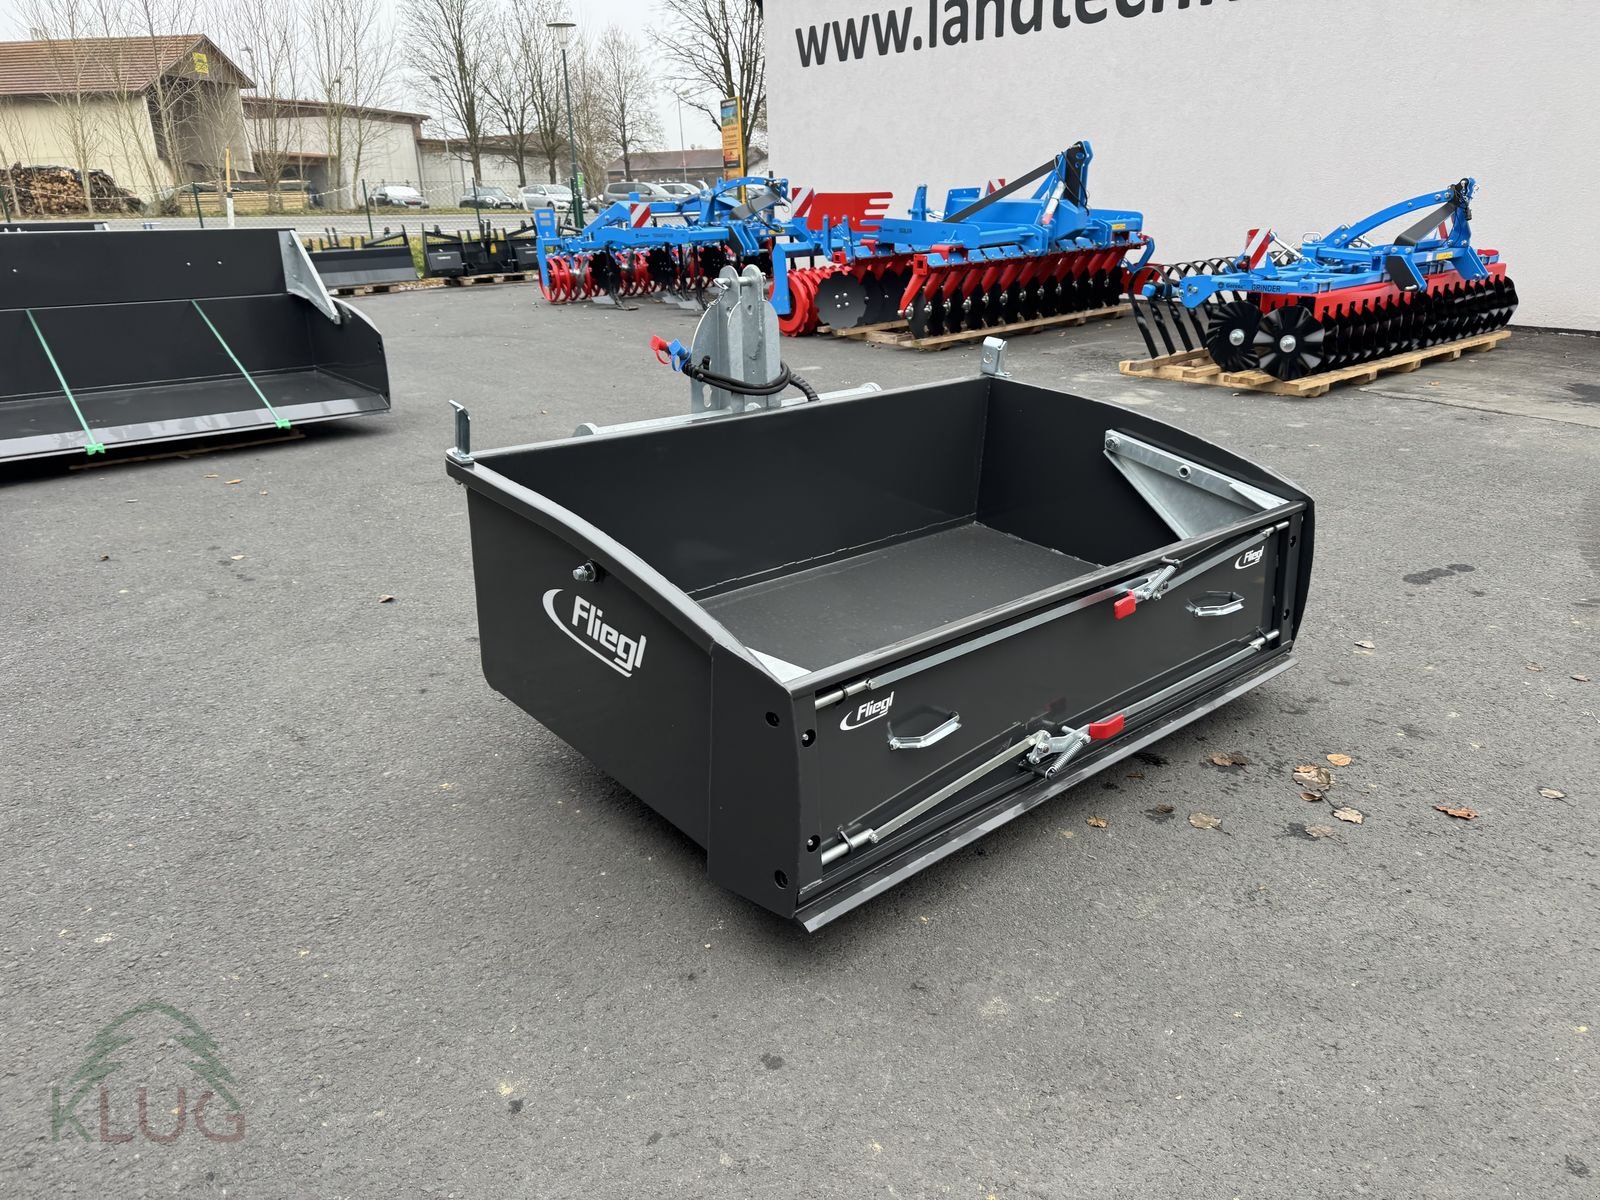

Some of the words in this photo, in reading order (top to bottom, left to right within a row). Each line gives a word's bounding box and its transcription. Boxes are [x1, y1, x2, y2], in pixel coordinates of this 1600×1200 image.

[794, 0, 1237, 68] www.landte
[1251, 284, 1281, 293] GRINDER
[1243, 545, 1265, 564] Fliegl
[571, 595, 647, 672] Fliegl
[856, 690, 895, 721] Fliegl
